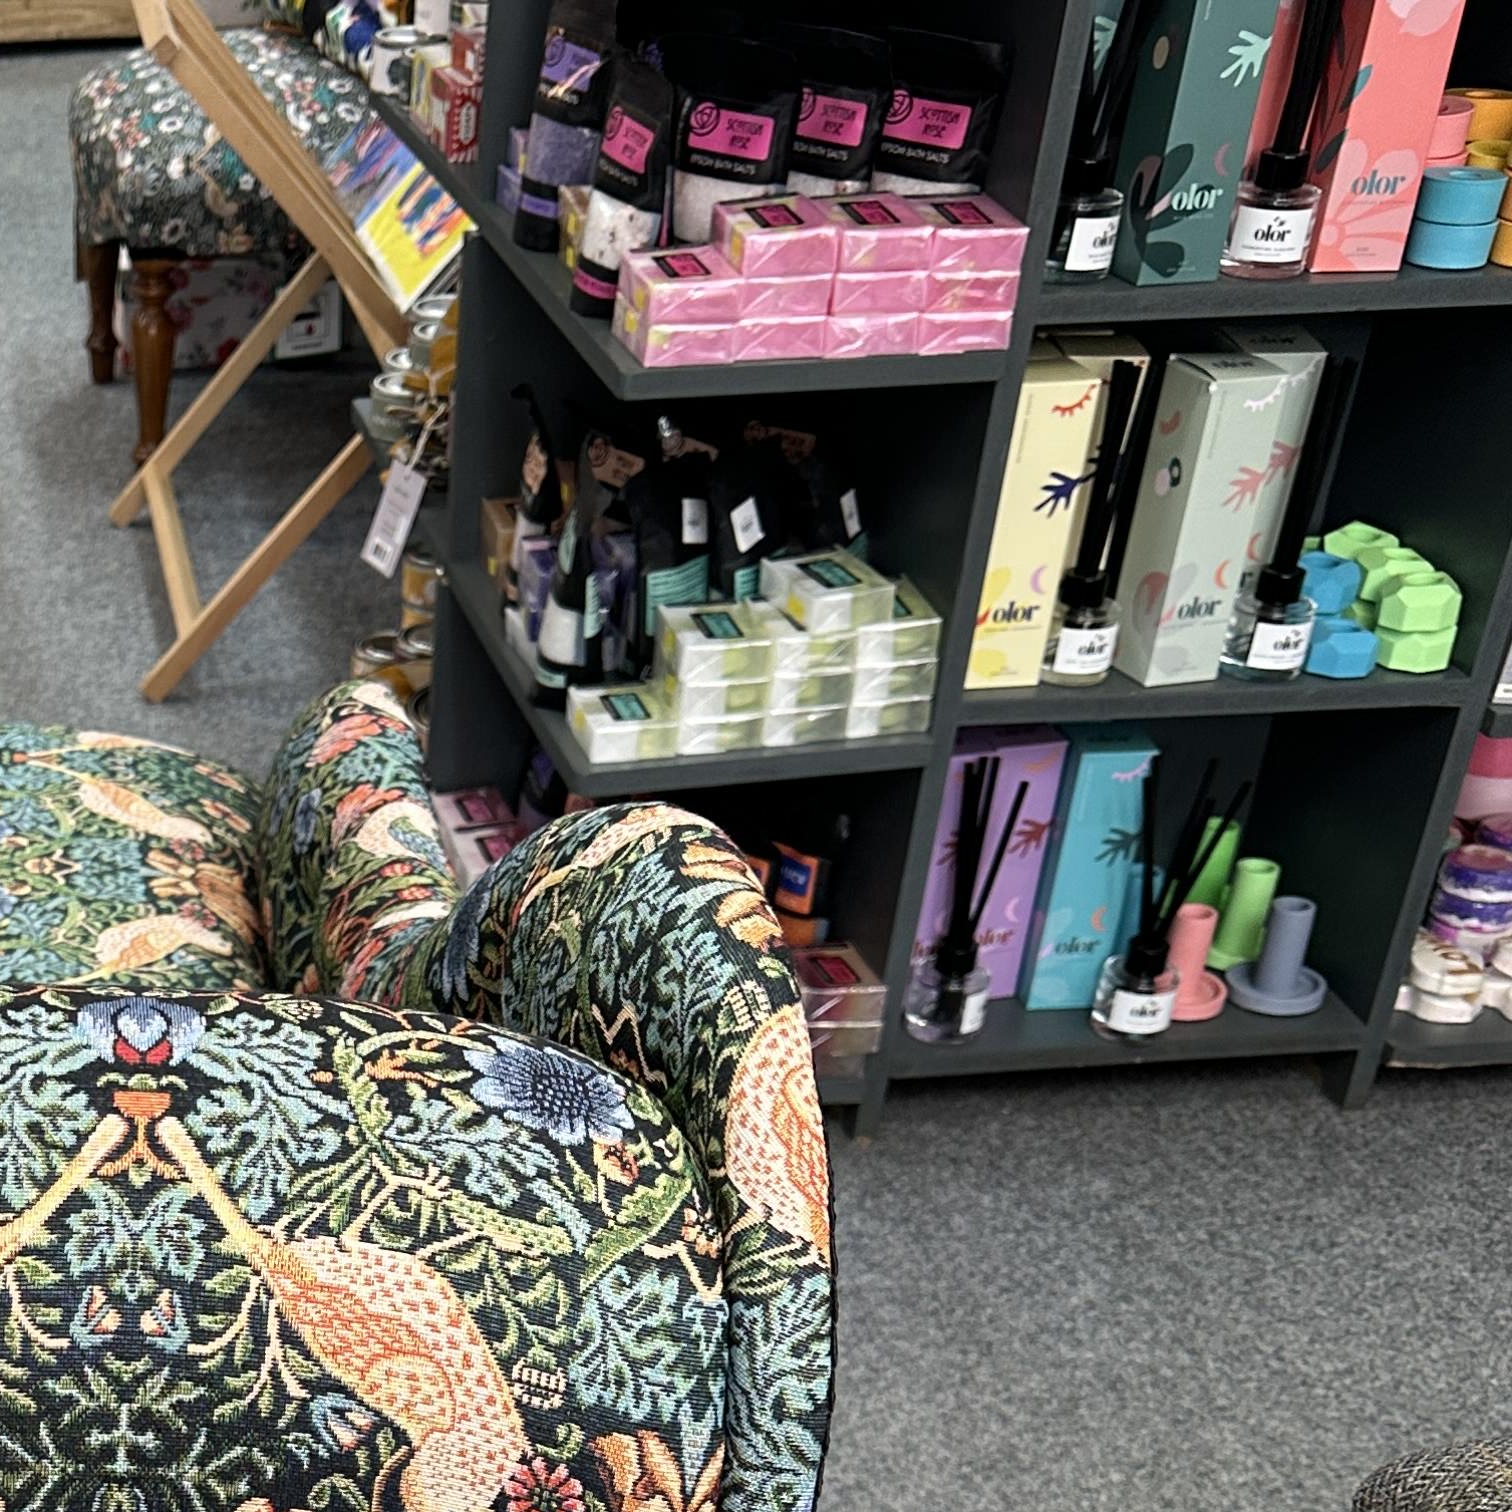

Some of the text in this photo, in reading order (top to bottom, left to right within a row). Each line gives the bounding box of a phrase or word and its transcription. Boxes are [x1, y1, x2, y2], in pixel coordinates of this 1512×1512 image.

[1350, 169, 1406, 196] olor
[1171, 182, 1224, 211] olor
[1254, 225, 1291, 242] olor
[992, 600, 1041, 624] olor
[1178, 596, 1222, 619] olor
[1055, 936, 1101, 954] olor
